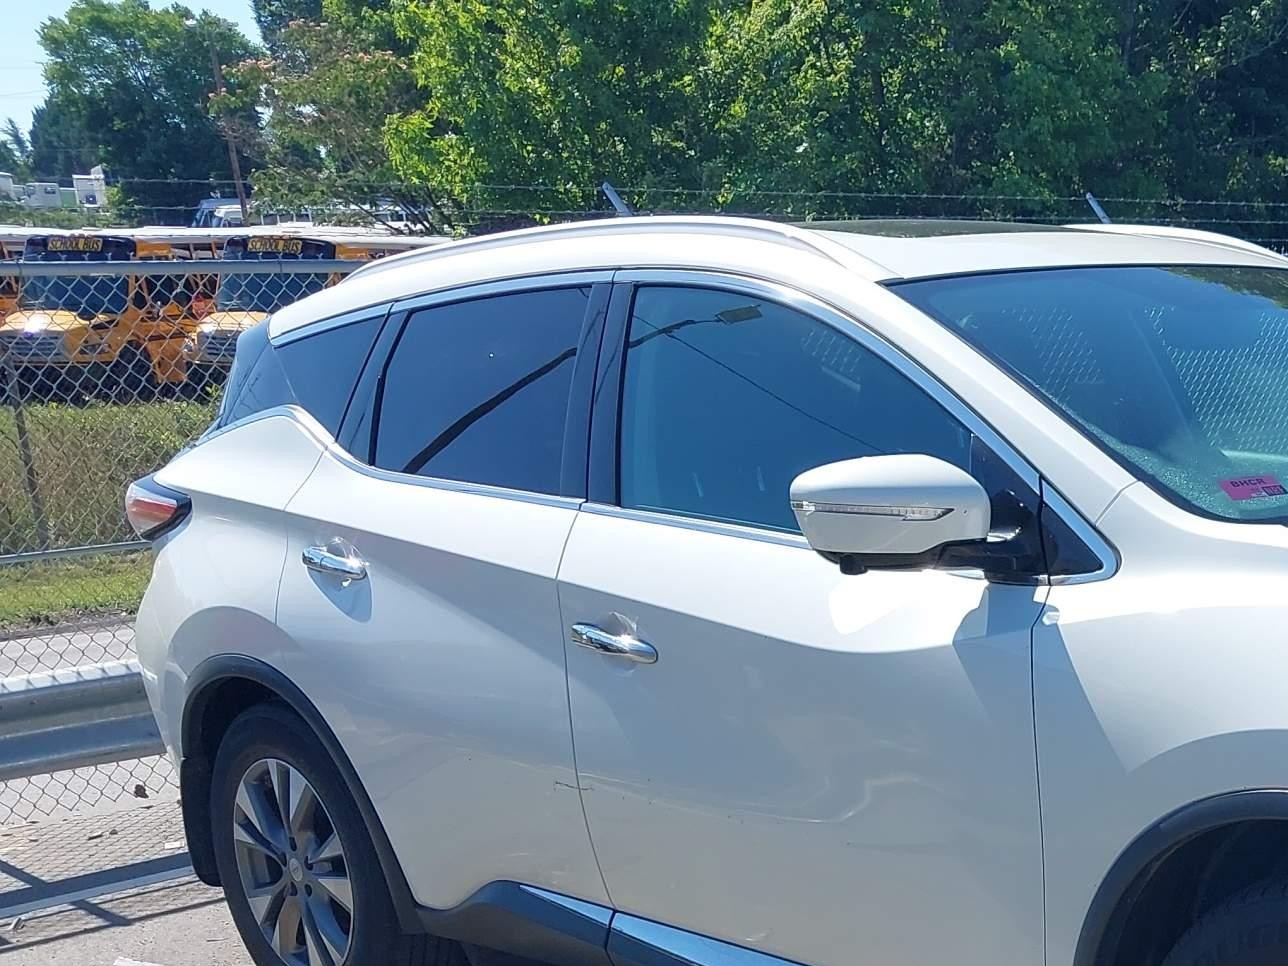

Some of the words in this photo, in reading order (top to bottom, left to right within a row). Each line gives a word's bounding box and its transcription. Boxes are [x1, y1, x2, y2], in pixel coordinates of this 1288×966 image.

[49, 239, 80, 250] SCHOOL
[82, 239, 102, 250] BUS
[249, 239, 278, 250] SCHOOL
[282, 240, 302, 252] BUS
